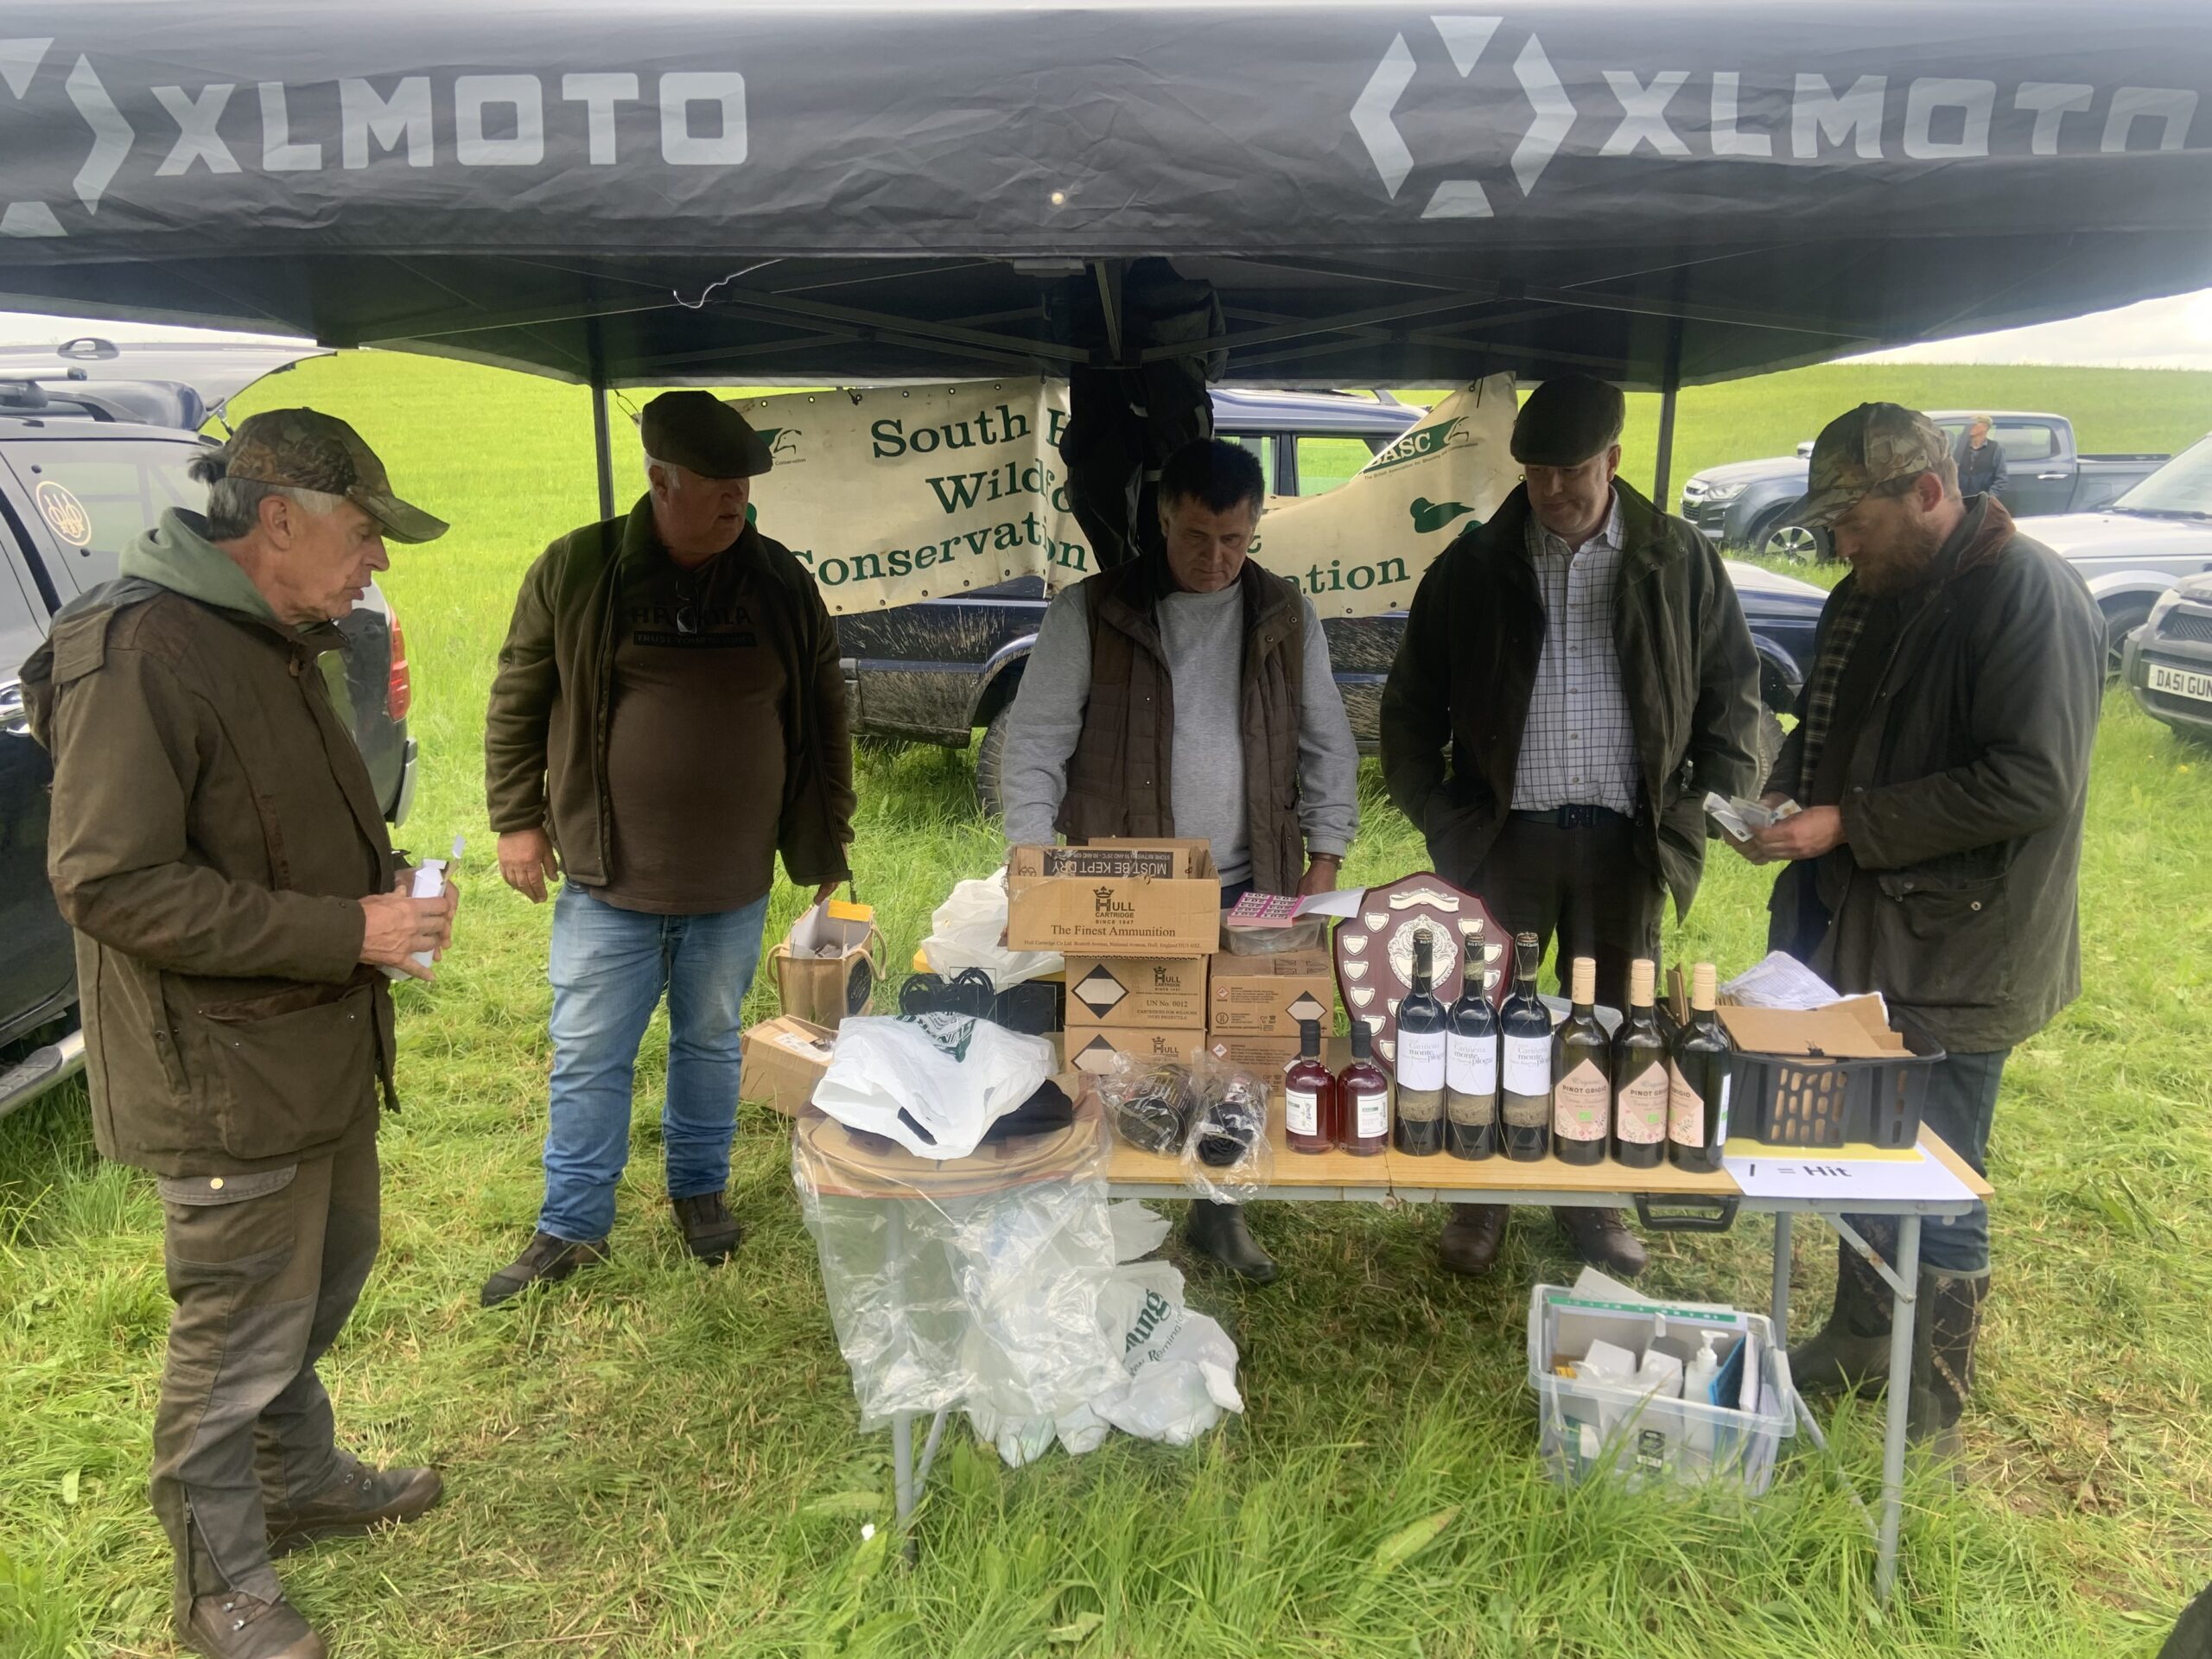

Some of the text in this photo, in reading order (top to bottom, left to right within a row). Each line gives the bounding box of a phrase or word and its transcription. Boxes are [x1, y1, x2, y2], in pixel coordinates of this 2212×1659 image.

[1597, 70, 2198, 159] XLMOTO
[150, 72, 748, 176] XLMOTO
[870, 404, 1031, 459] South
[1371, 432, 1431, 466] ASC
[1052, 861, 1167, 875] MUST BE KEPT DRY
[1096, 898, 1135, 912] HULL
[1051, 925, 1176, 938] The Finest Ammunition
[1154, 974, 1181, 983] HULL
[1154, 1043, 1179, 1053] HULL
[1562, 1084, 1607, 1094] PINOT GRIGIO
[1802, 1166, 1853, 1178] Hit
